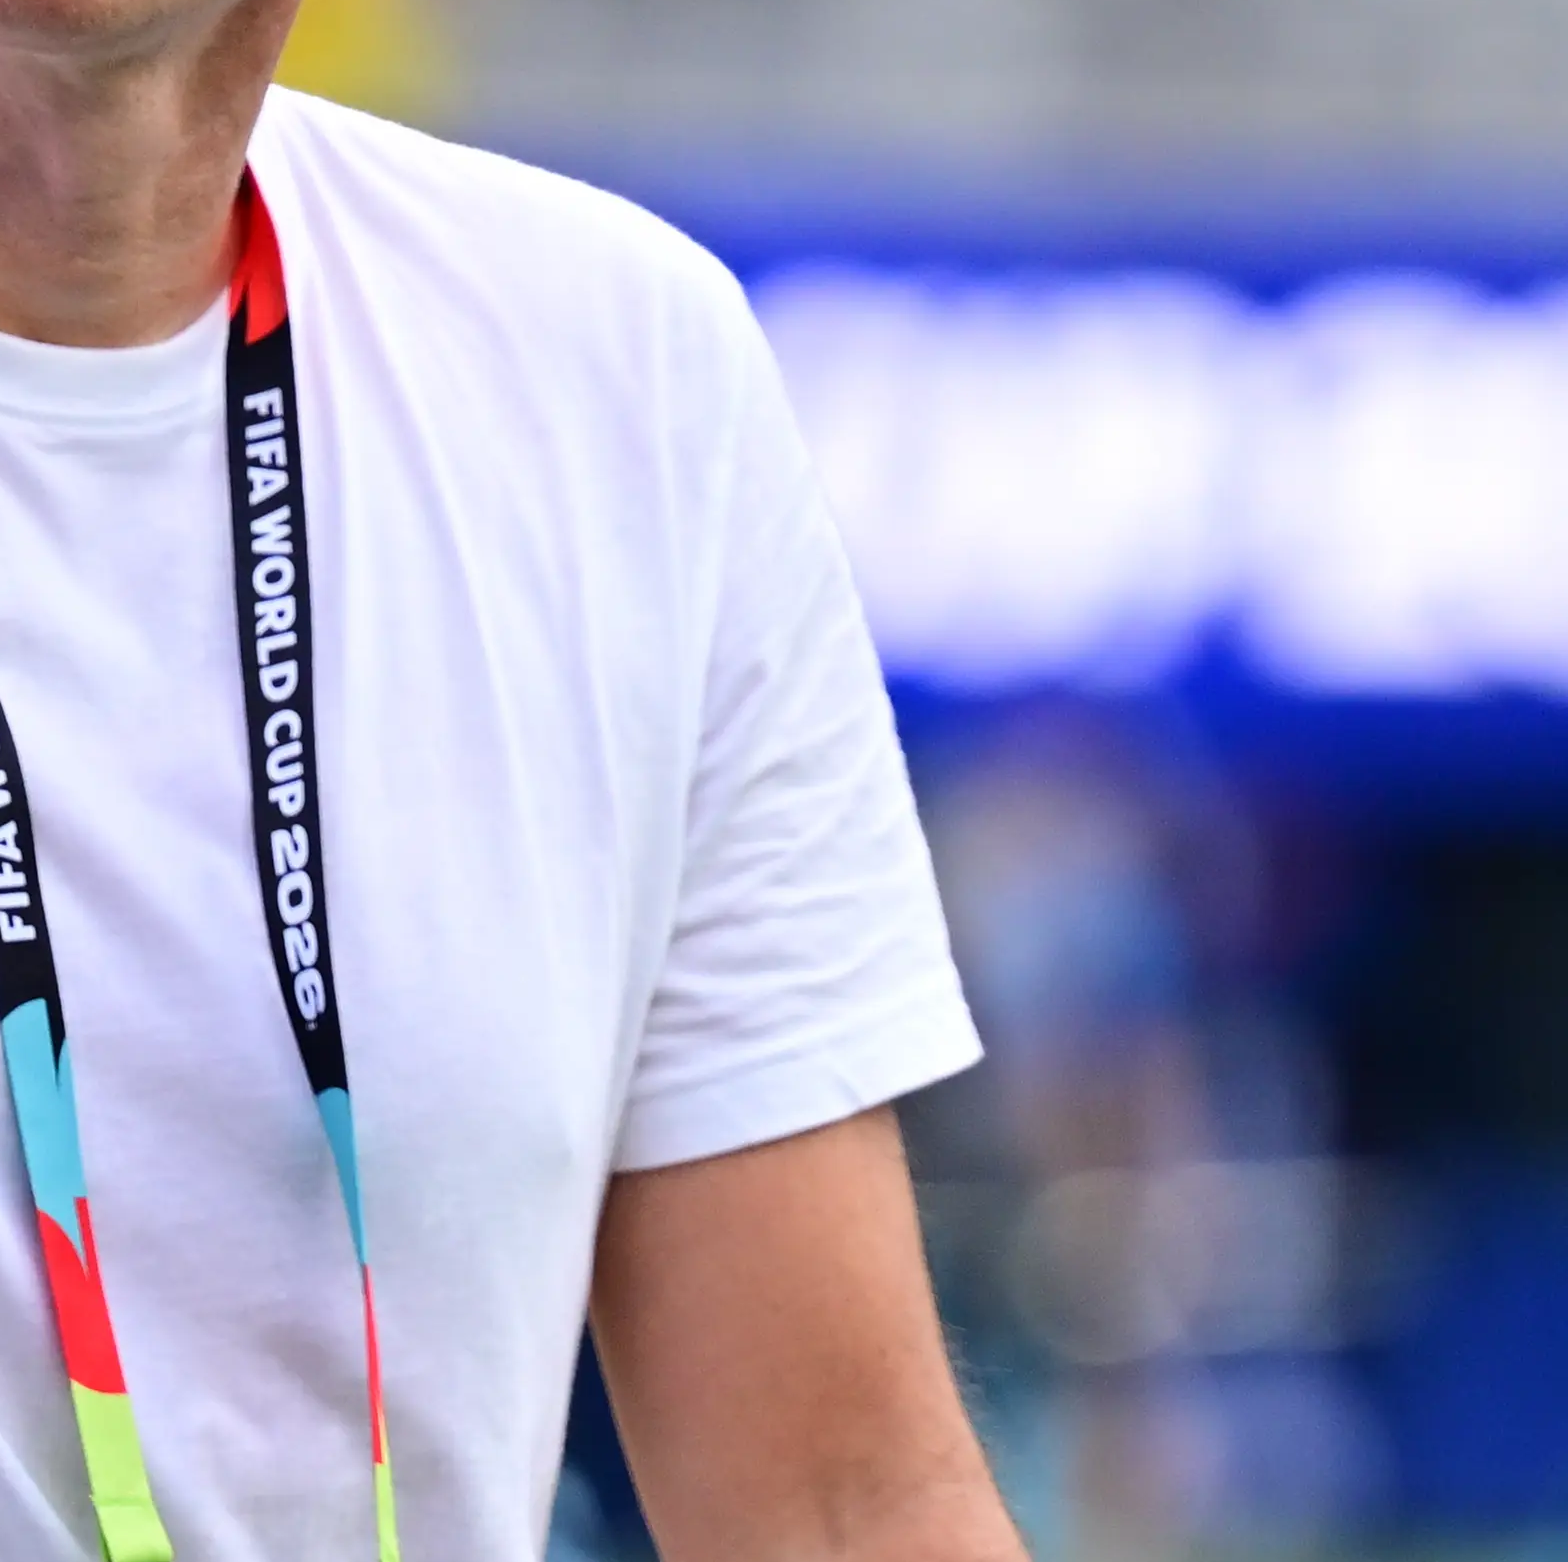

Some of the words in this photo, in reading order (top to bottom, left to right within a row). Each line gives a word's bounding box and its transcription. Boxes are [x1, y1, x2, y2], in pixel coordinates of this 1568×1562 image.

[243, 387, 289, 506] FIFA
[250, 505, 299, 703] WORLD
[264, 708, 305, 817] CUP
[270, 823, 326, 1021] 2026
